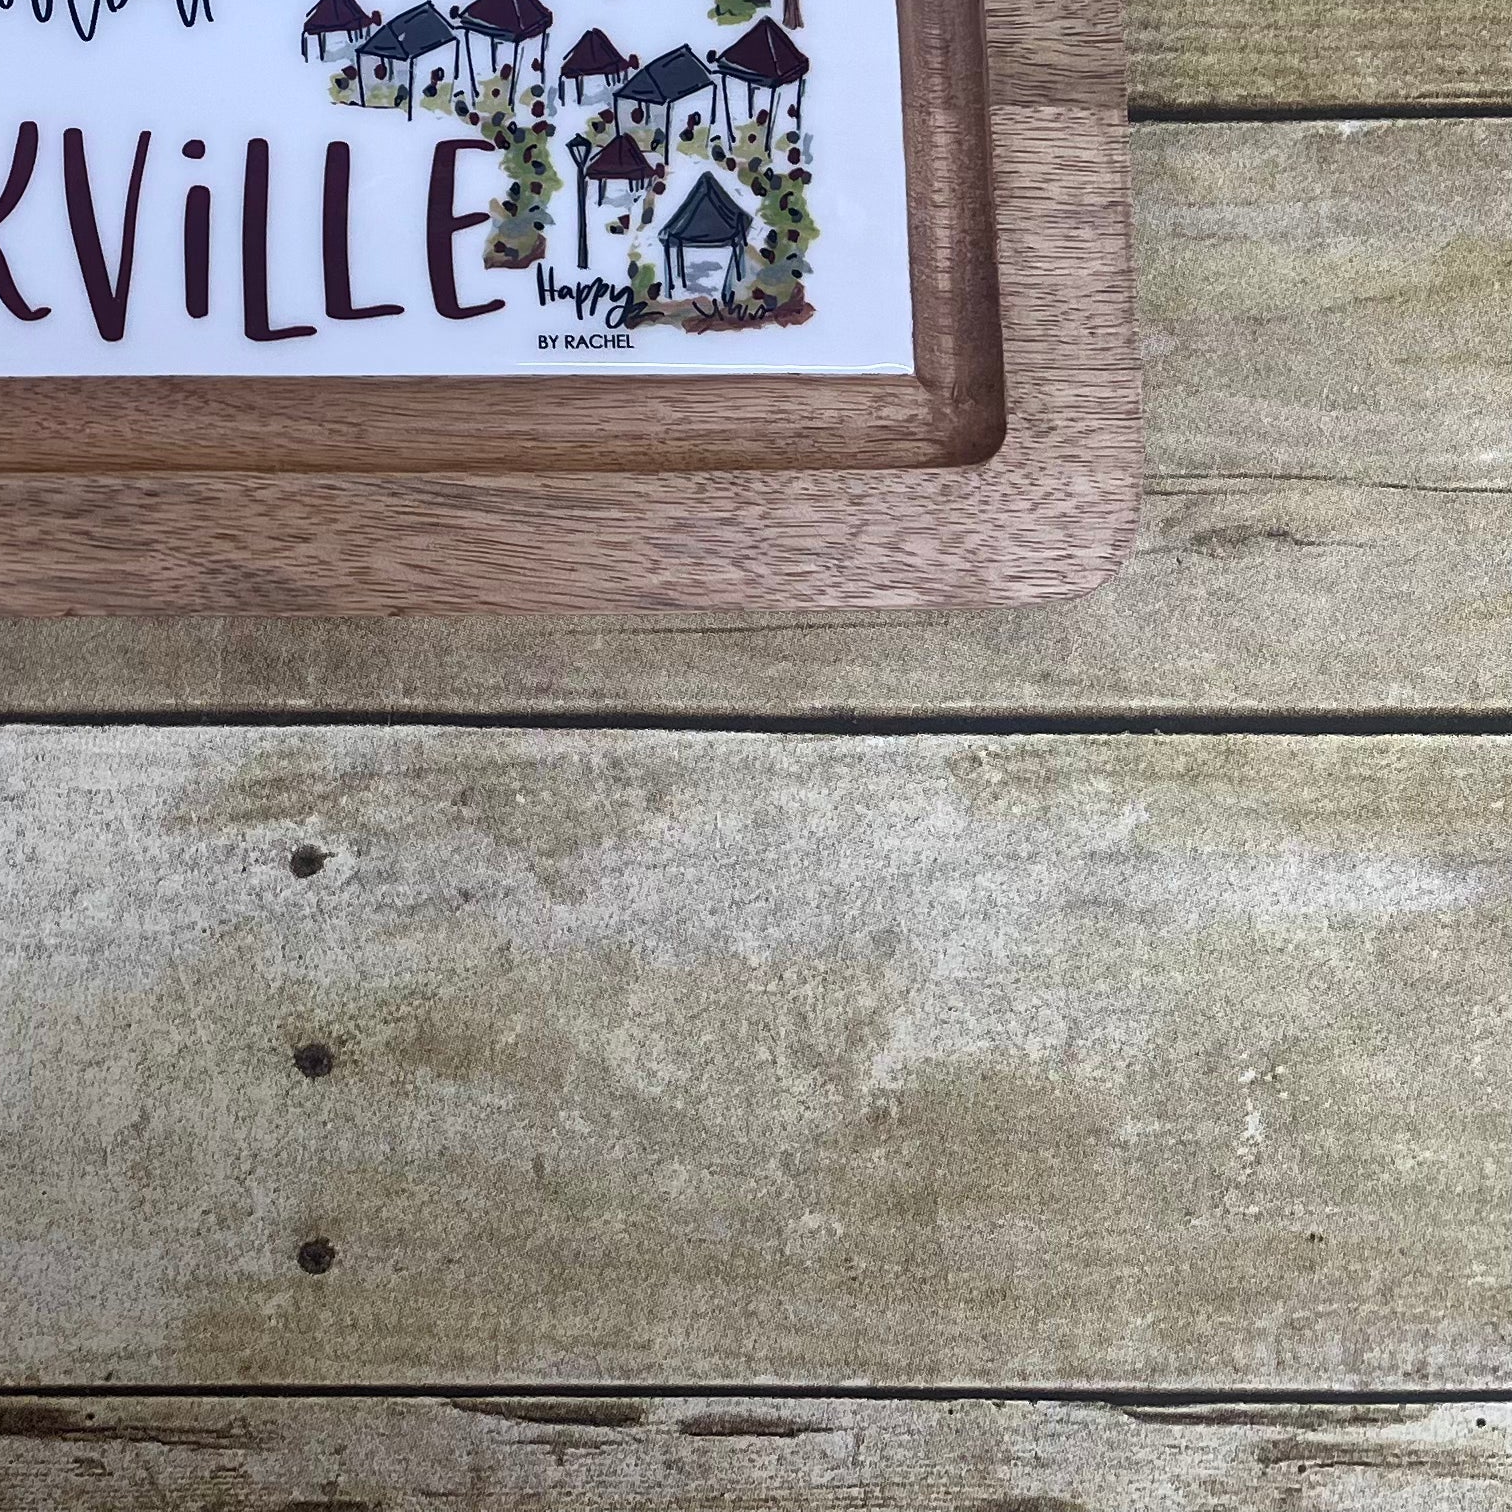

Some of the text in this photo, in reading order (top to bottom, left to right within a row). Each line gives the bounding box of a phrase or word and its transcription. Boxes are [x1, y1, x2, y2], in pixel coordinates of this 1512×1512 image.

[535, 262, 649, 329] Happy
[538, 334, 635, 349] BY RACHEL
